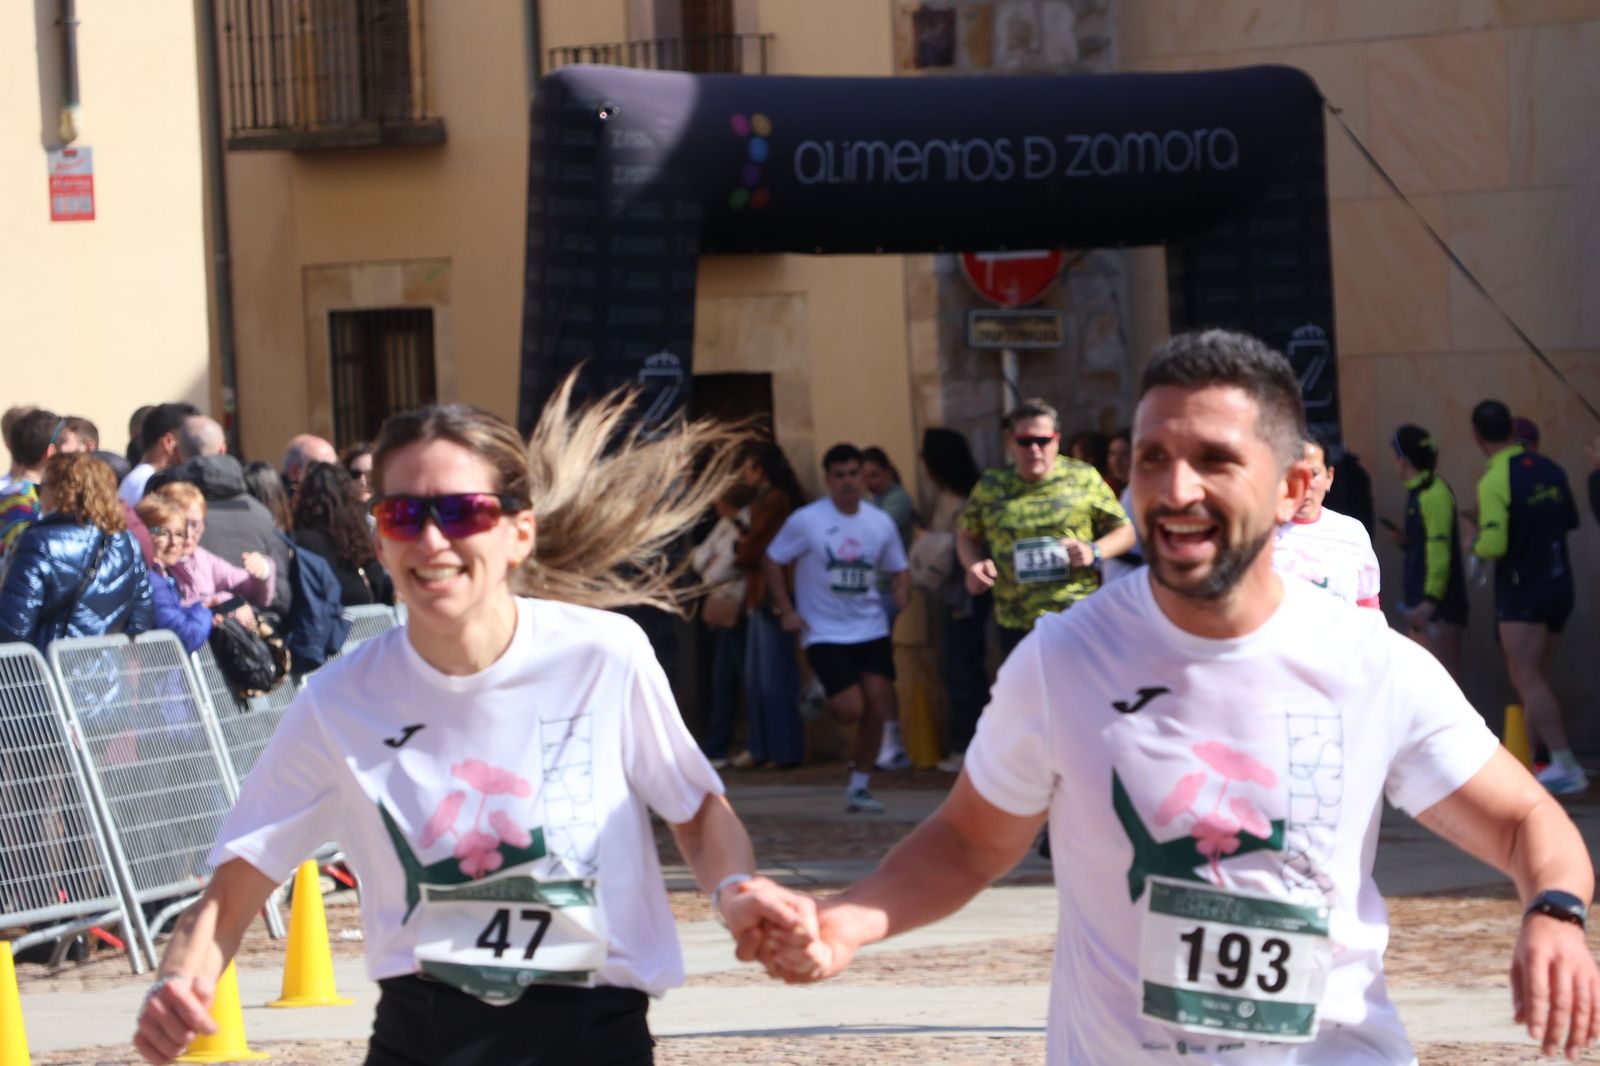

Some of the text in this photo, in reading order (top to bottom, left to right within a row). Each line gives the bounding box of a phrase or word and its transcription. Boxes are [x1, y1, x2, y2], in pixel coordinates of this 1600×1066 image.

[1064, 127, 1240, 177] zamora
[475, 908, 552, 960] 47
[1180, 925, 1292, 994] 193
